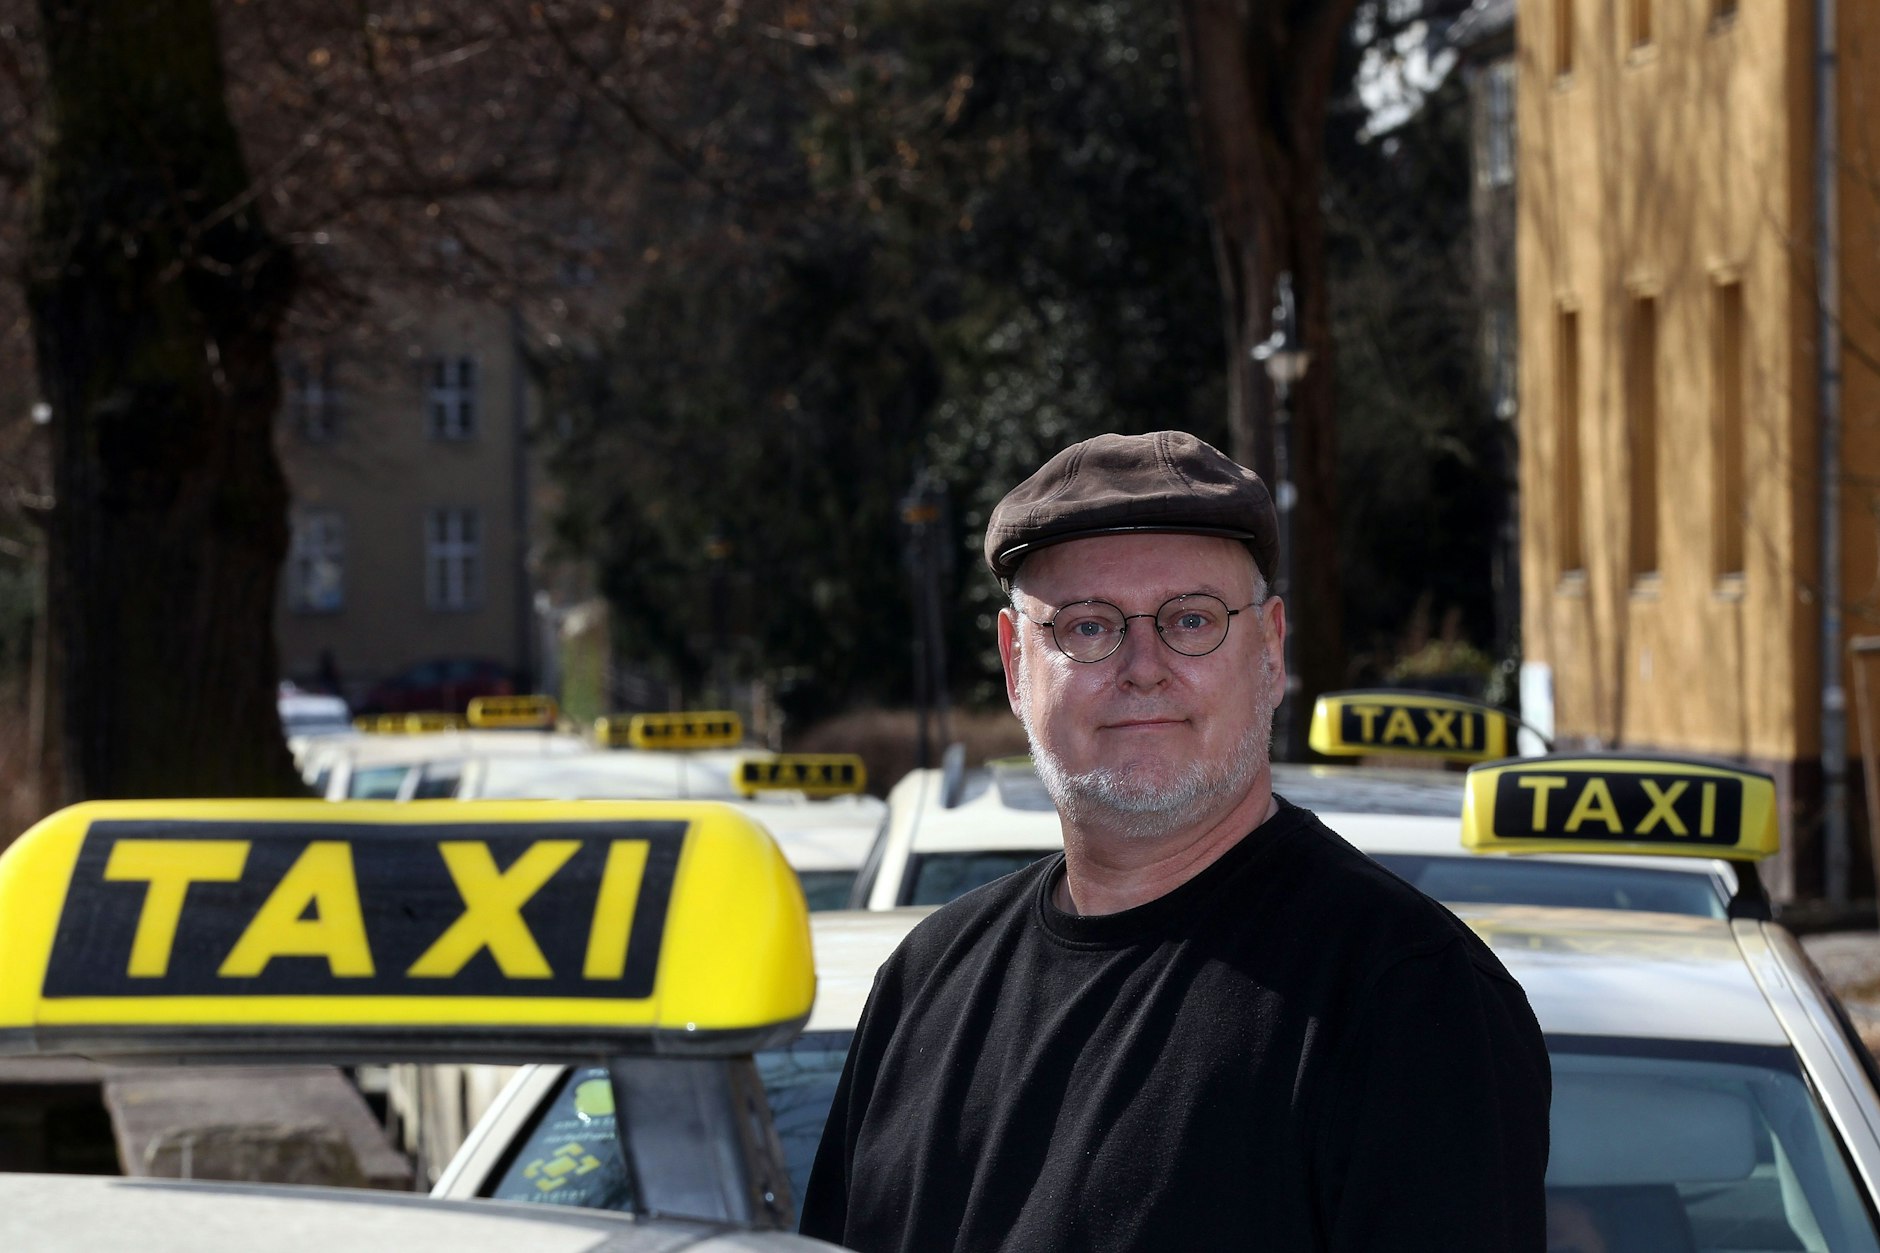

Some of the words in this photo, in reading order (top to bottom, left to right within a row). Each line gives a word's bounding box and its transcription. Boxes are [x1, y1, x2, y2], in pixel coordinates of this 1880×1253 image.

[1351, 705, 1475, 749] TAXI
[1518, 775, 1717, 837] TAXI
[103, 839, 651, 979] TAXI
